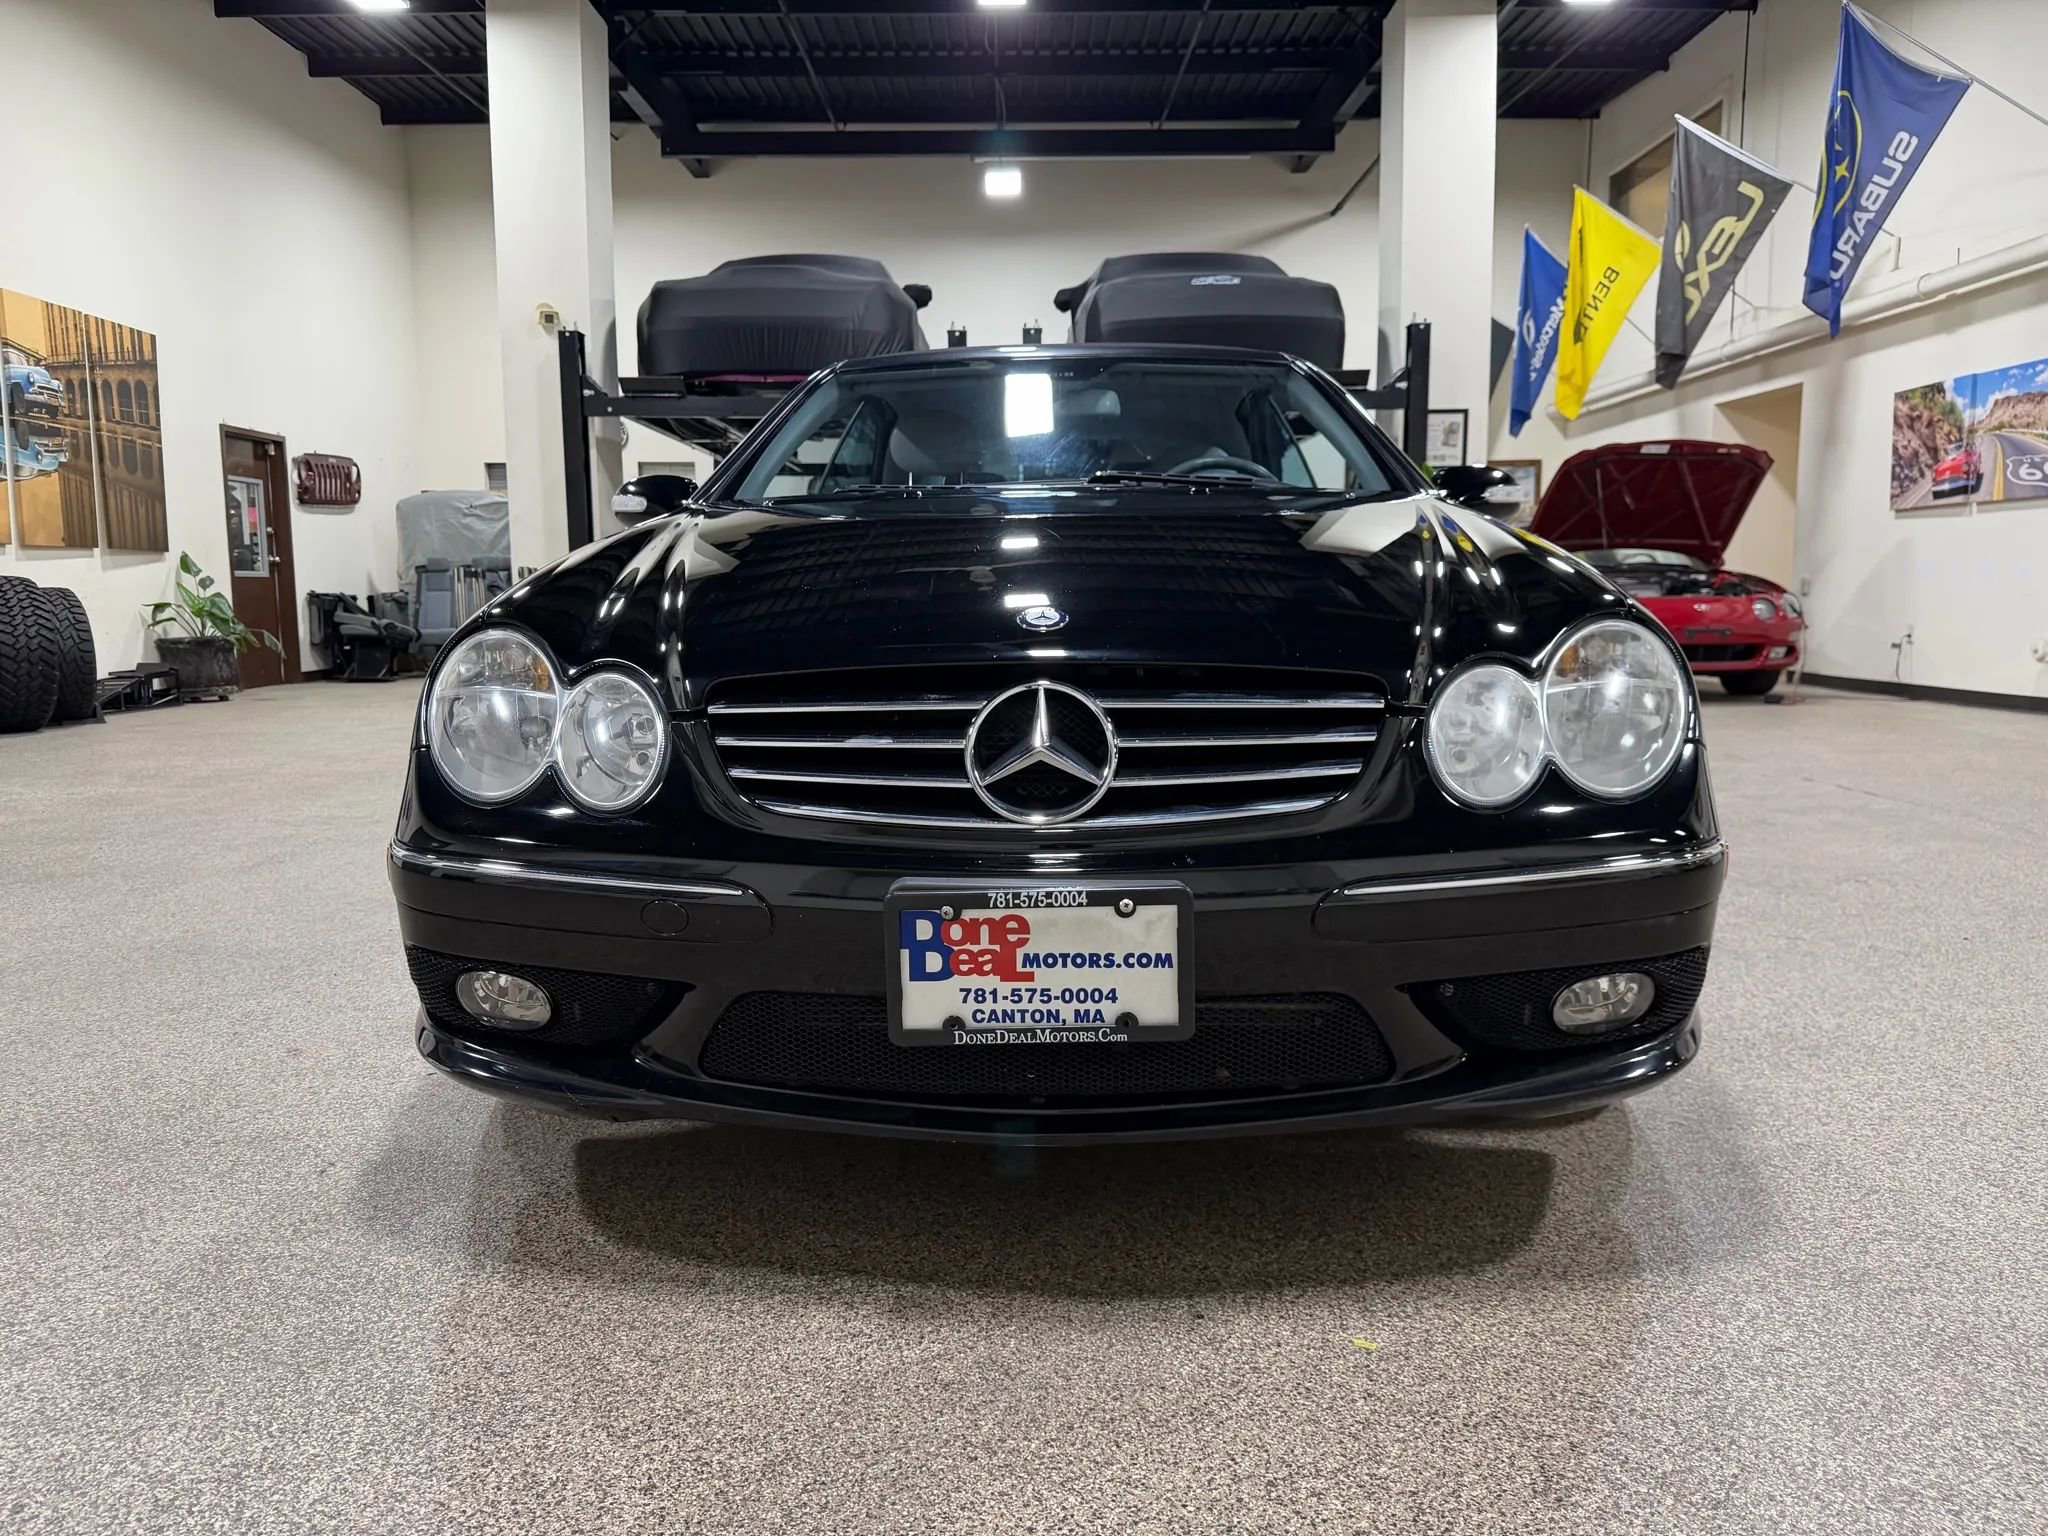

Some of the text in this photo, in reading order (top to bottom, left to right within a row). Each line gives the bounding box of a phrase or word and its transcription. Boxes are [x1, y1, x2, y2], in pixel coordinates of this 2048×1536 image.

[987, 890, 1088, 908] 781-575-0004
[899, 910, 1031, 950] Done
[1021, 952, 1174, 969] MOTORS.COM
[959, 987, 1119, 1005] 781-575-0004
[971, 1008, 1106, 1026] CANTON, MA
